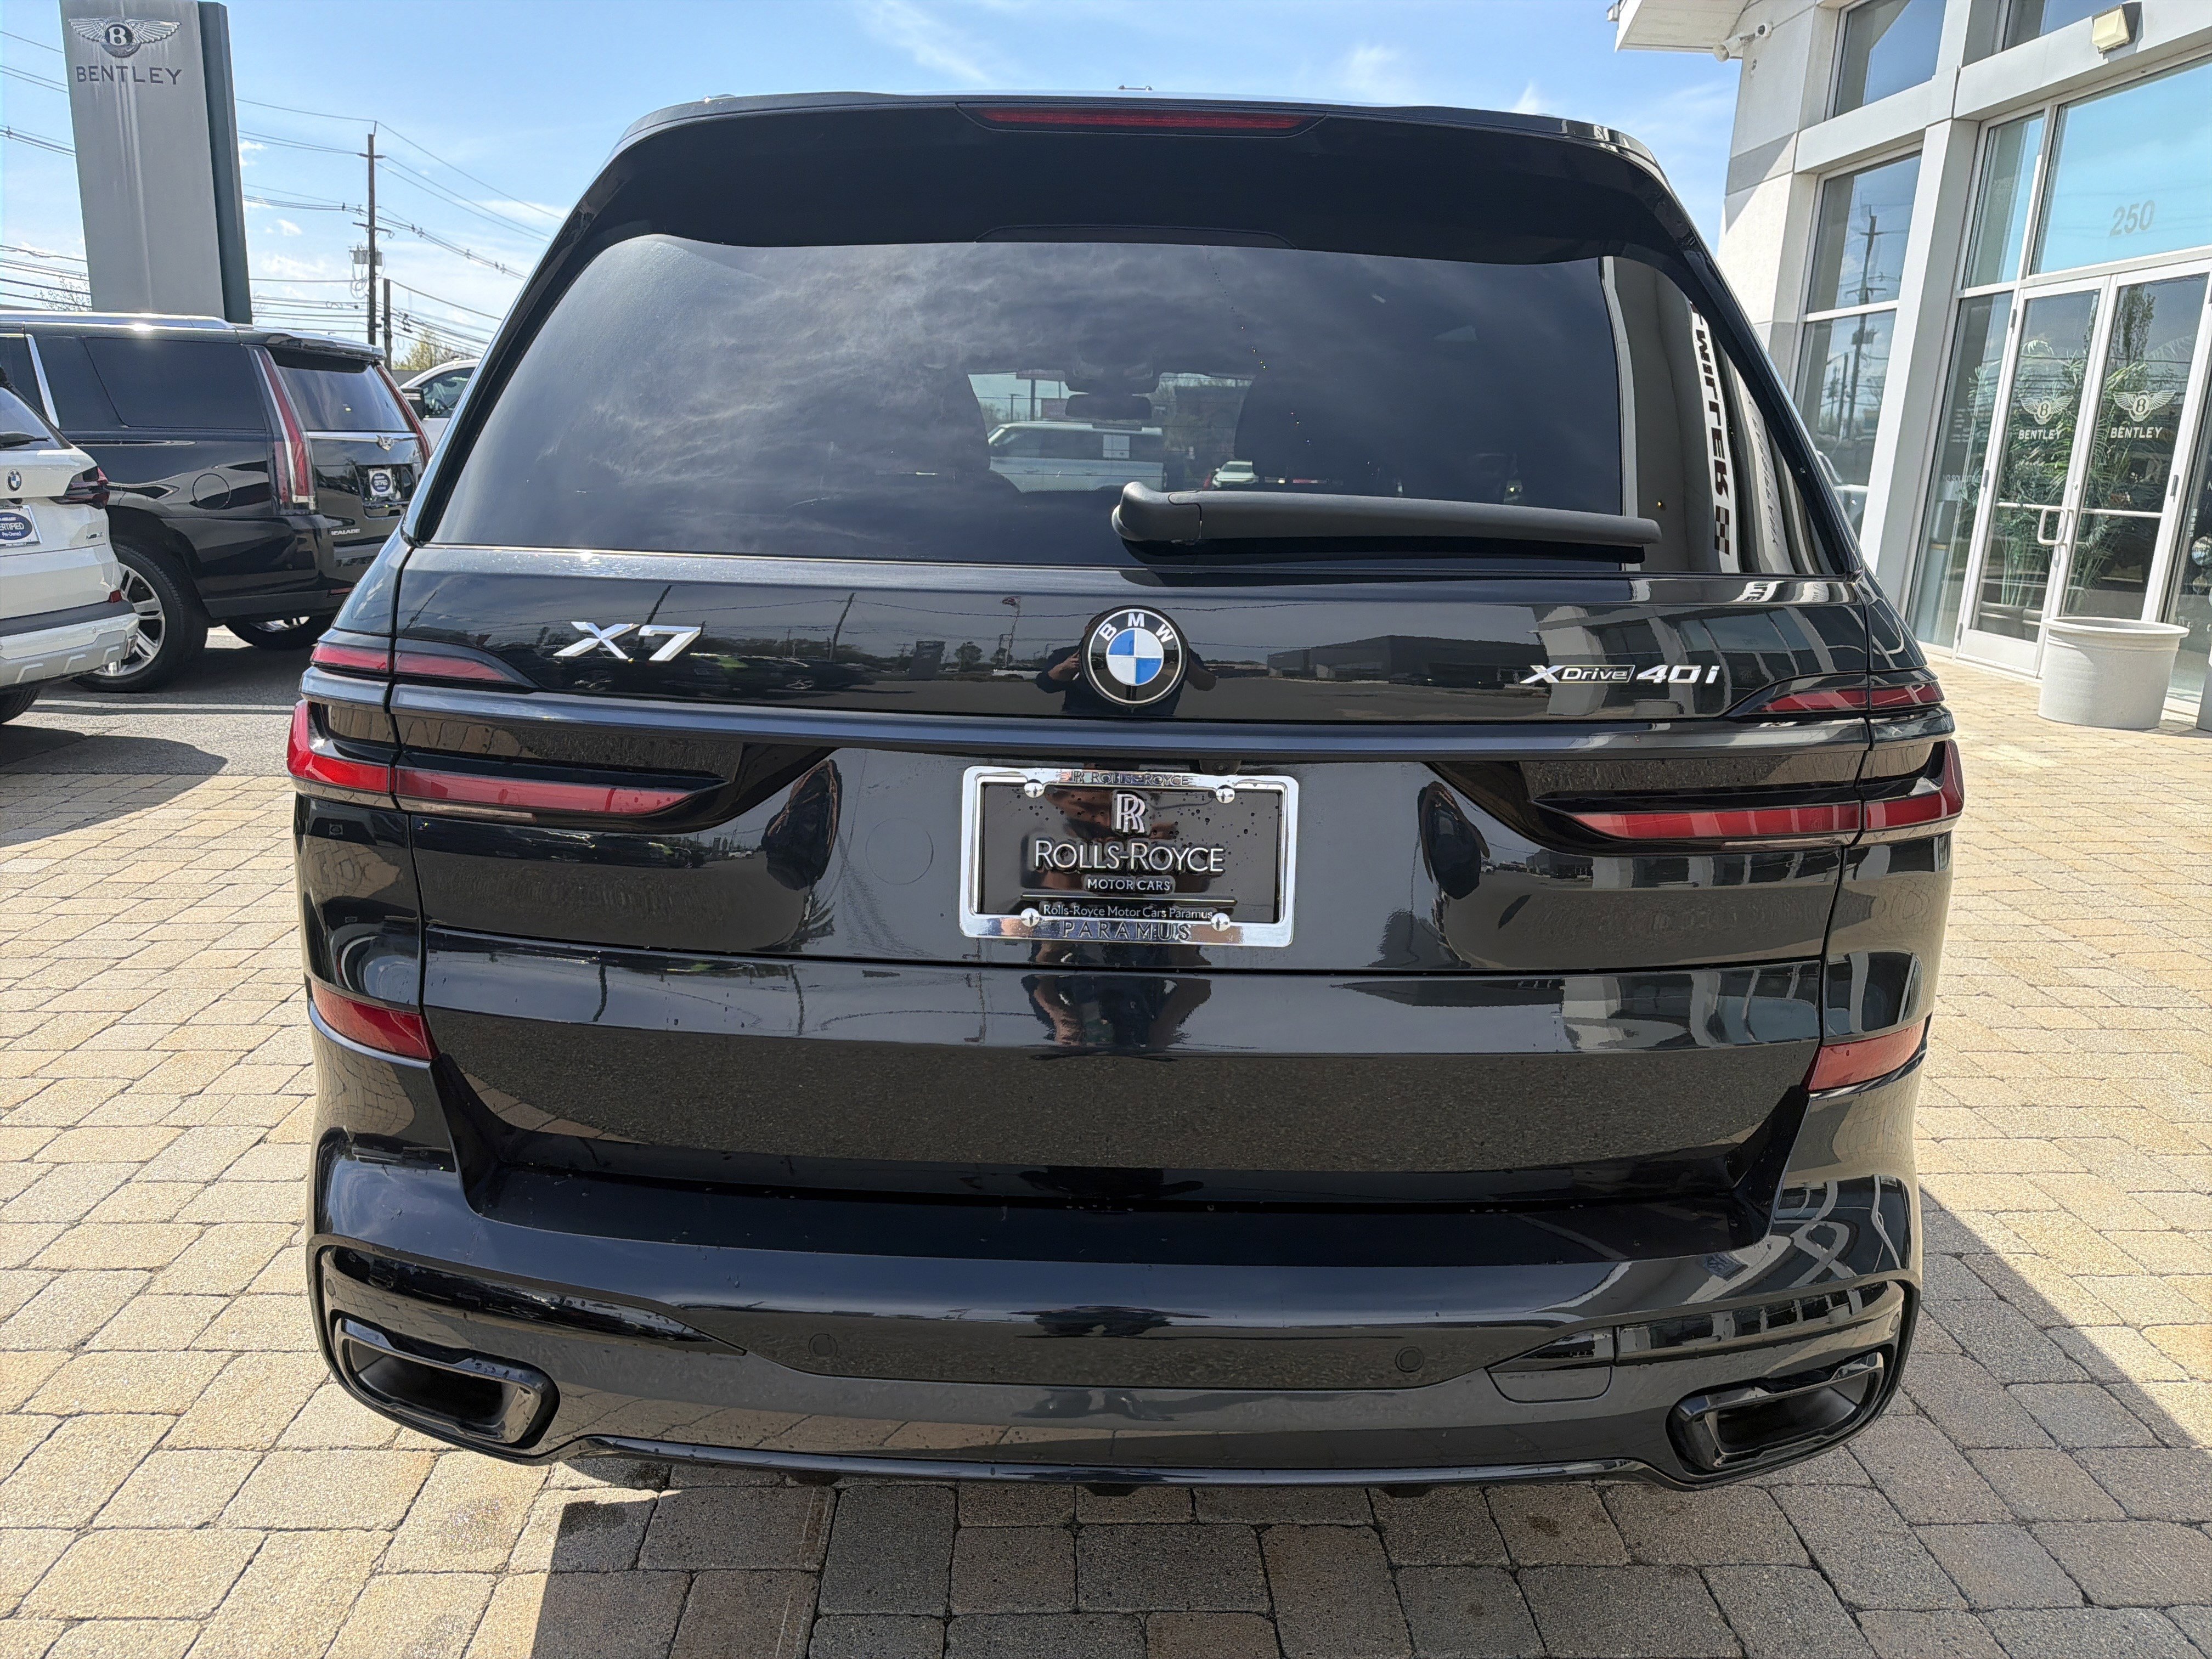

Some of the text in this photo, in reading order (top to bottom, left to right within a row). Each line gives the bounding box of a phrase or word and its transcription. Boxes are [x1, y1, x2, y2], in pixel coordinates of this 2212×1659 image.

[108, 26, 127, 47] B
[76, 65, 182, 85] BENTLEY
[2109, 200, 2155, 237] 250
[2018, 427, 2062, 440] BENTLEY
[2110, 426, 2163, 438] BENTLEY
[0, 522, 25, 531] ERTIFIED
[1099, 613, 1175, 643] BMW
[553, 621, 701, 662] X7
[1091, 771, 1189, 786] ROLLS-ROYCE
[1035, 840, 1224, 873] ROLLS-ROYCE
[1087, 878, 1171, 891] MOTOR CARS
[1043, 904, 1213, 919] Rolls-Royce Motor Cars Paramus
[1062, 920, 1191, 941] PARAMUS
